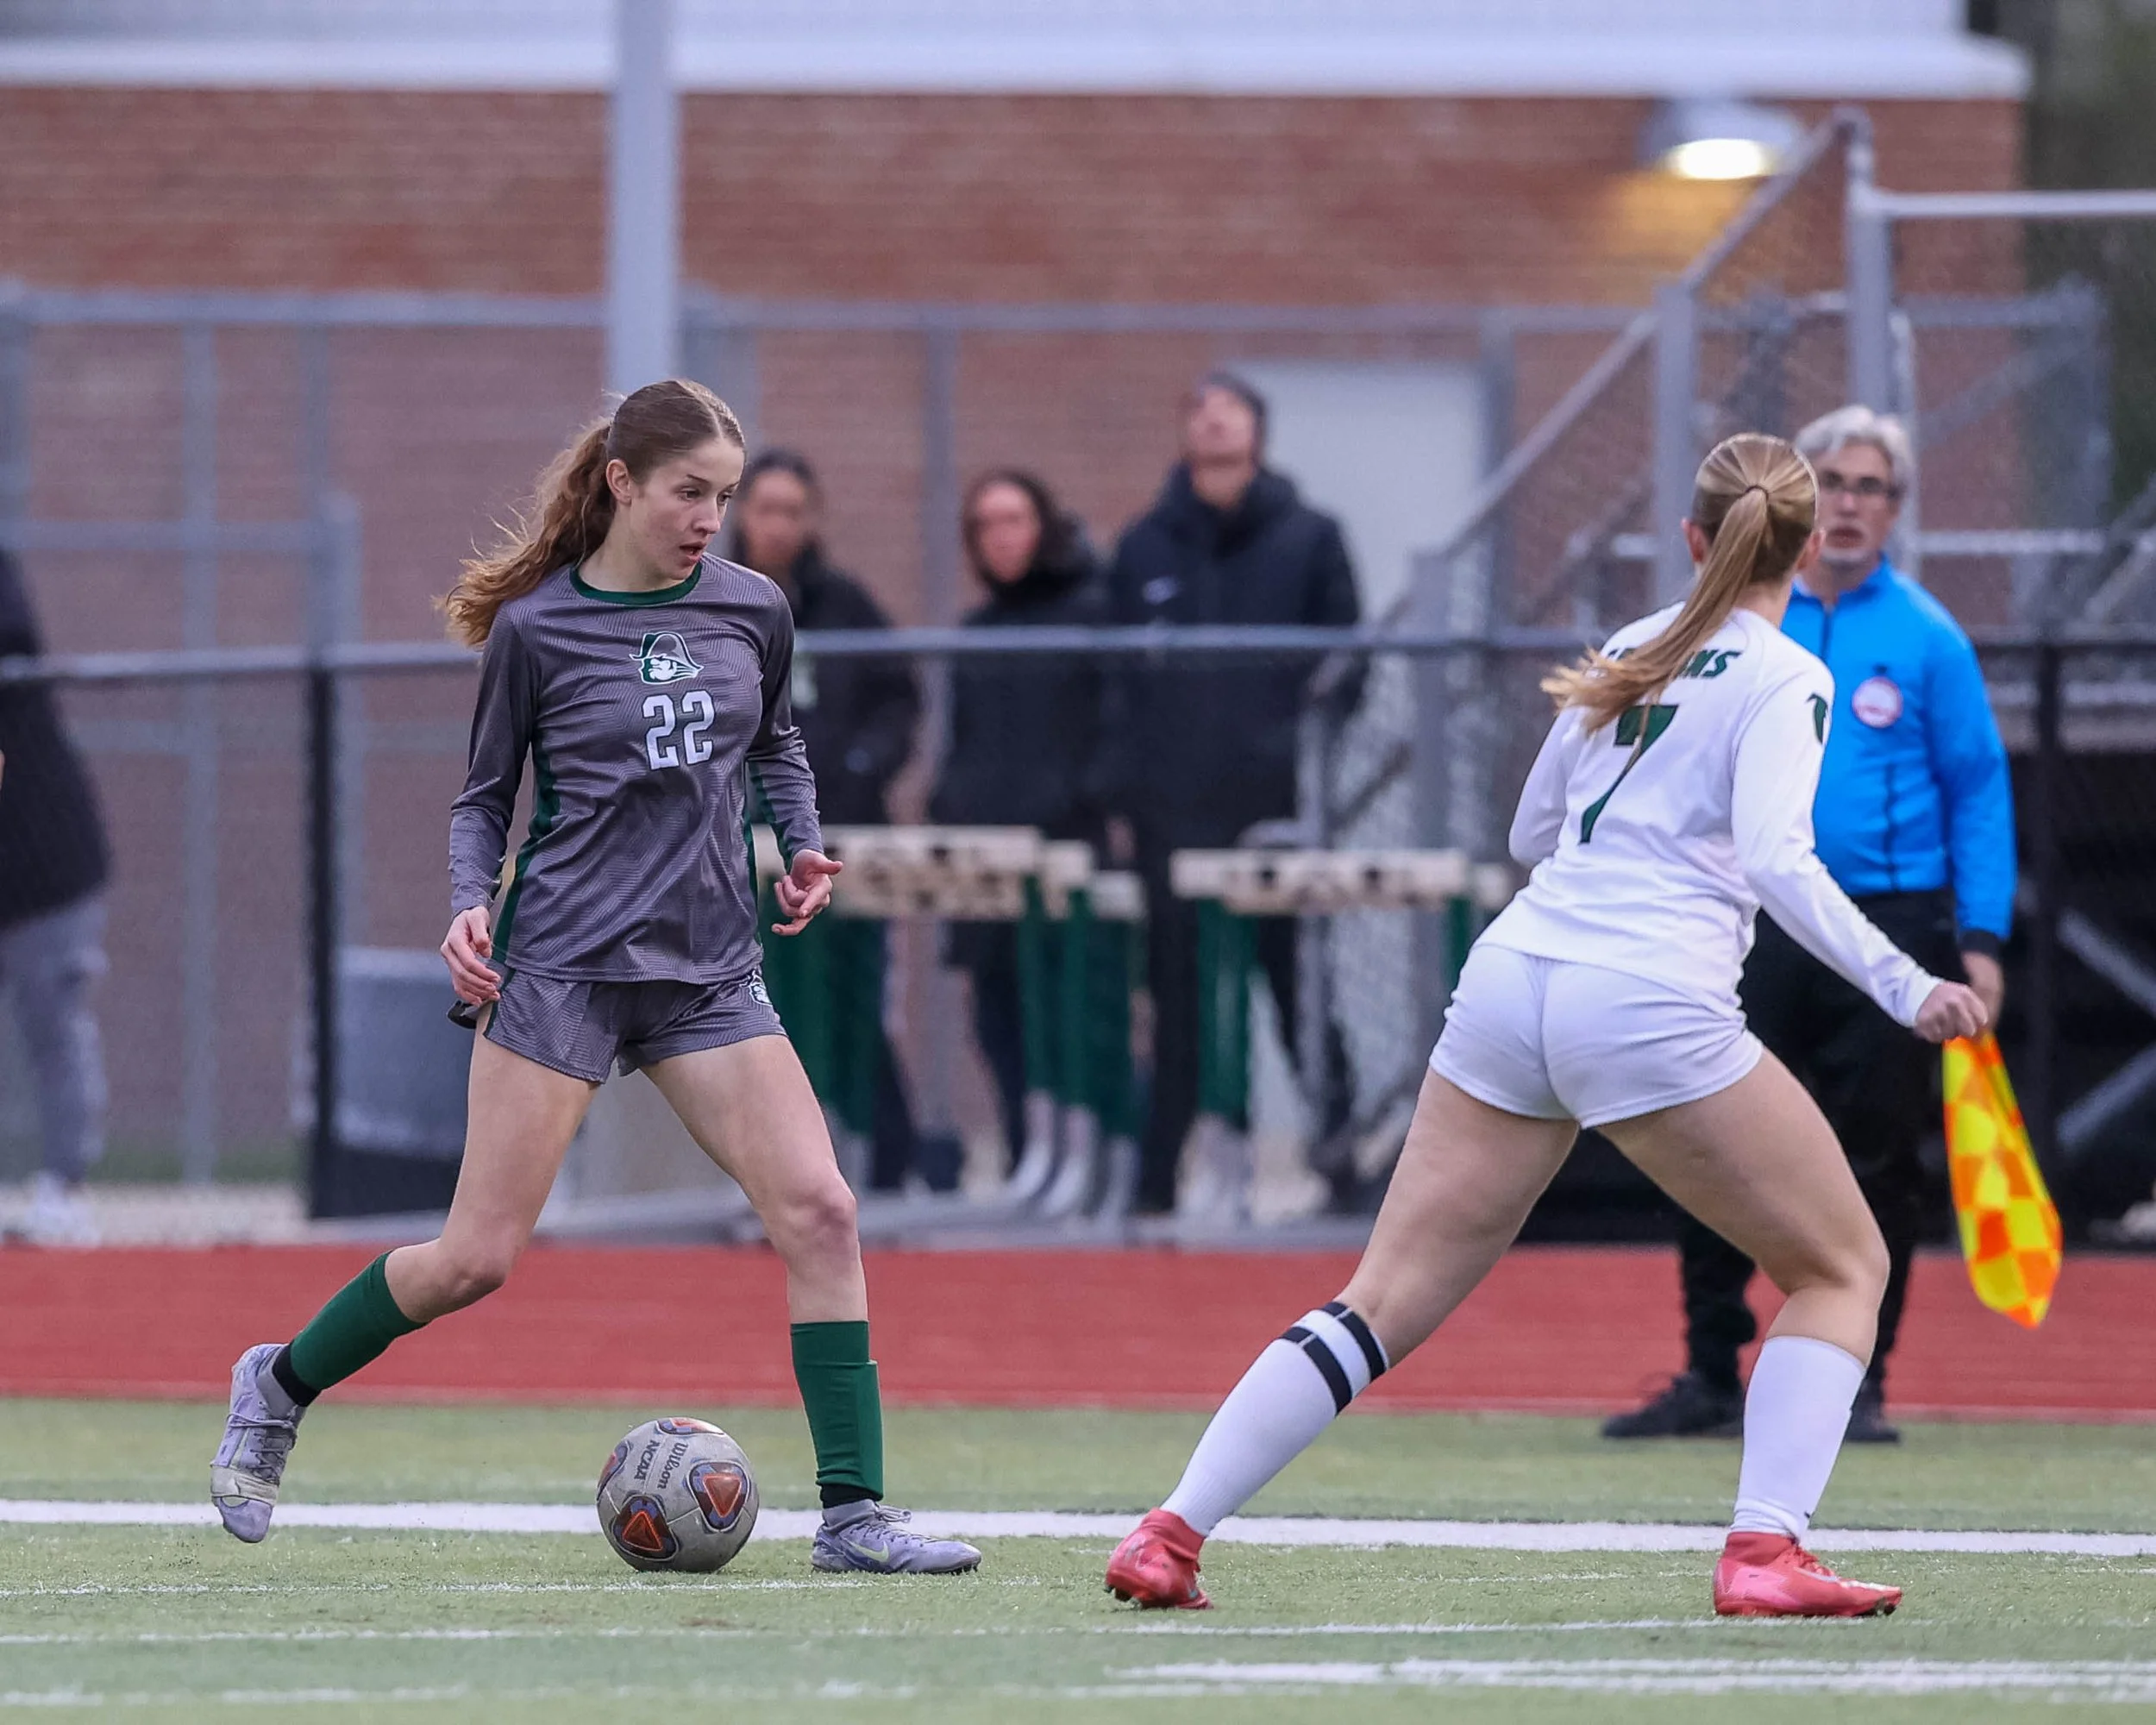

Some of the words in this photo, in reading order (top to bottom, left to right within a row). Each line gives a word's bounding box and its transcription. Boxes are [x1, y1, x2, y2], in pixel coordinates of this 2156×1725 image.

[642, 690, 715, 769] 22
[1578, 704, 1679, 844] 7
[634, 1440, 661, 1481] NCAA
[657, 1442, 688, 1490] Wilson
